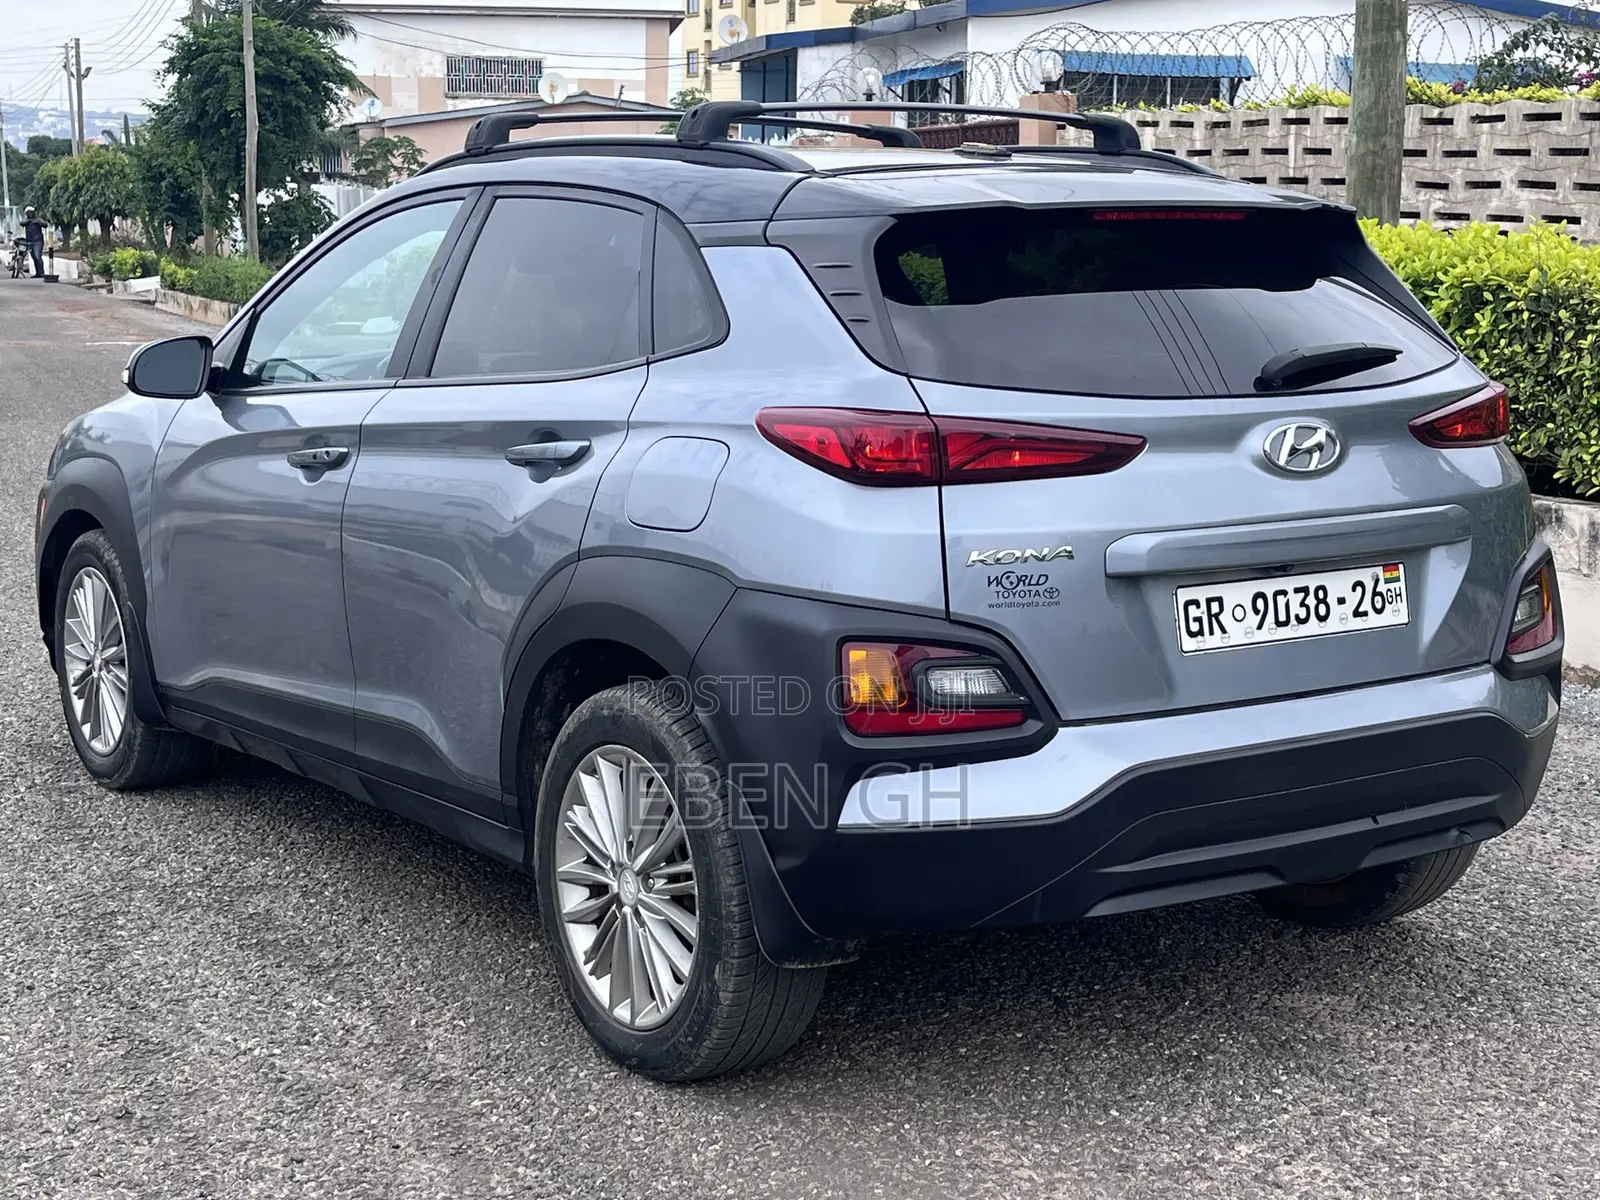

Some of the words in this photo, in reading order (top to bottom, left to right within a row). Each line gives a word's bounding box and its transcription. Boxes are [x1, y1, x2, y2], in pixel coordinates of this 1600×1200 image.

[965, 545, 1075, 568] KONA
[994, 590, 1042, 600] TOYOTA
[987, 600, 1061, 609] worldtoyota.com
[1182, 595, 1228, 639] GR
[1385, 585, 1404, 606] GH
